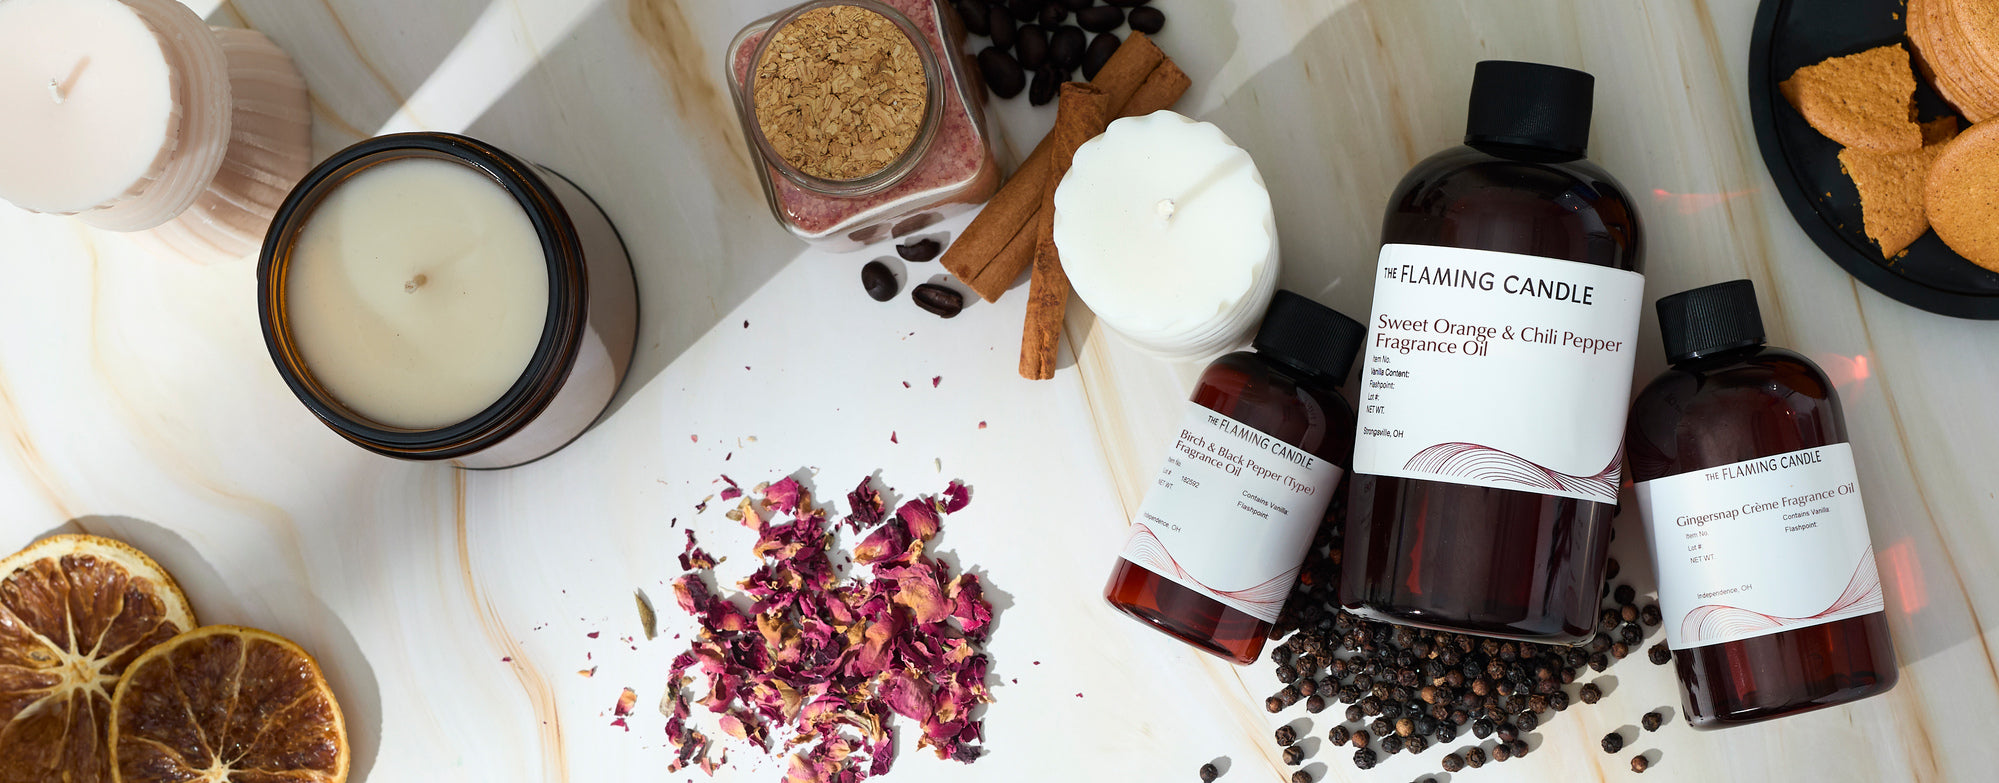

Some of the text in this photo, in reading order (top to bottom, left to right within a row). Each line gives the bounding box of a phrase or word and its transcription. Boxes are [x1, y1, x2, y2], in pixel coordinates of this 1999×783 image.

[1384, 264, 1594, 306] THE FLAMING CANDLE
[1376, 333, 1488, 357] Fragrance Oil
[1378, 314, 1623, 355] Sweet Orange & Chili Pepper
[1385, 368, 1410, 378] Content:
[1366, 405, 1375, 413] NET
[1208, 415, 1314, 470] THE FLAMING CANDLE
[1392, 430, 1404, 438] OH
[1176, 440, 1242, 477] Fragrance Oil
[1180, 429, 1316, 496] Birch & Black Pepper (Type)
[1705, 450, 1822, 482] THE FLAMING CANDLE
[1242, 490, 1268, 506] Contains
[1676, 482, 1854, 526] Gingersnap Crème Fragrance Oil
[1782, 510, 1810, 520] Contains
[1690, 556, 1702, 564] NET
